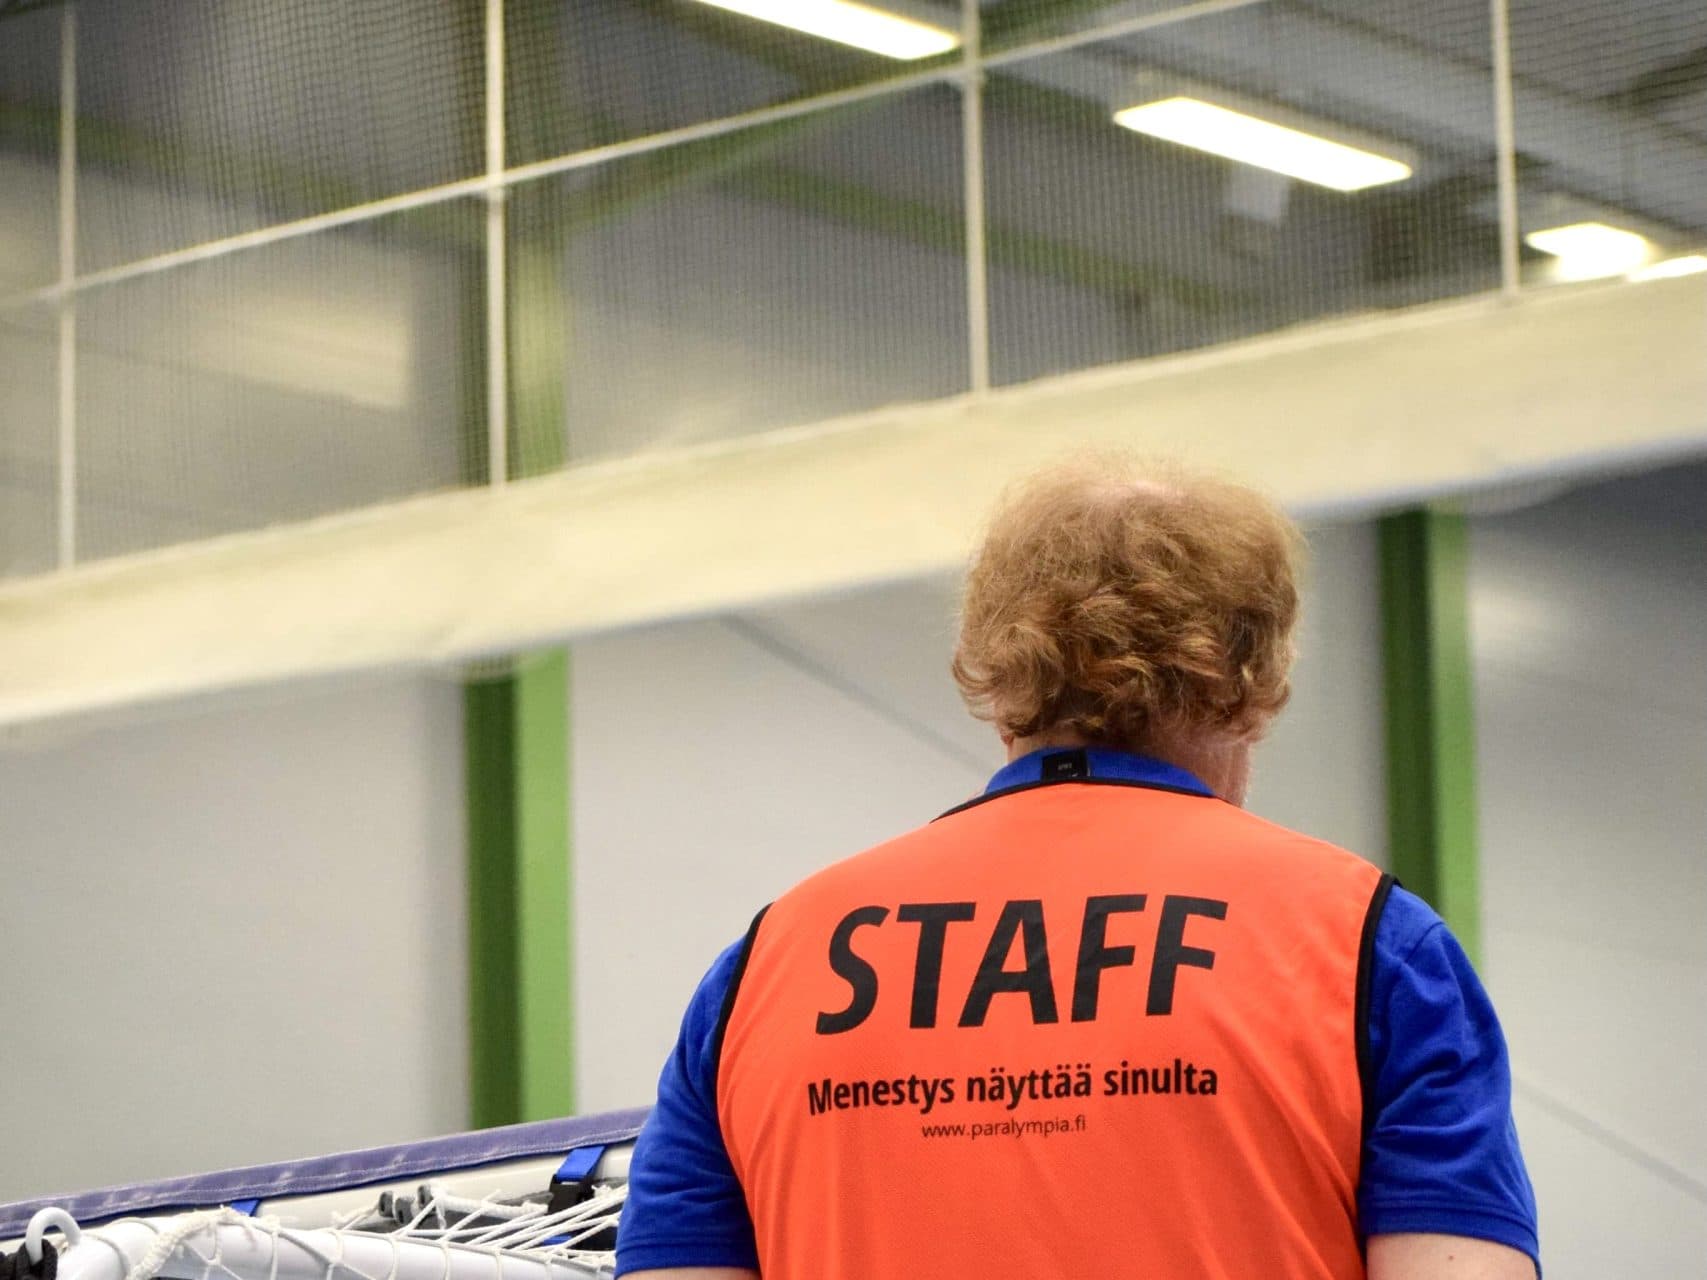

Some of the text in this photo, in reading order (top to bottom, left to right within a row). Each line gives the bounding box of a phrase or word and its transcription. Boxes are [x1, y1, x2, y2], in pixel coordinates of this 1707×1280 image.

[815, 894, 1228, 1035] STAFF
[808, 1058, 1218, 1116] Menestys näyttää sinulta
[921, 1114, 1087, 1140] www.paralympia.fi
